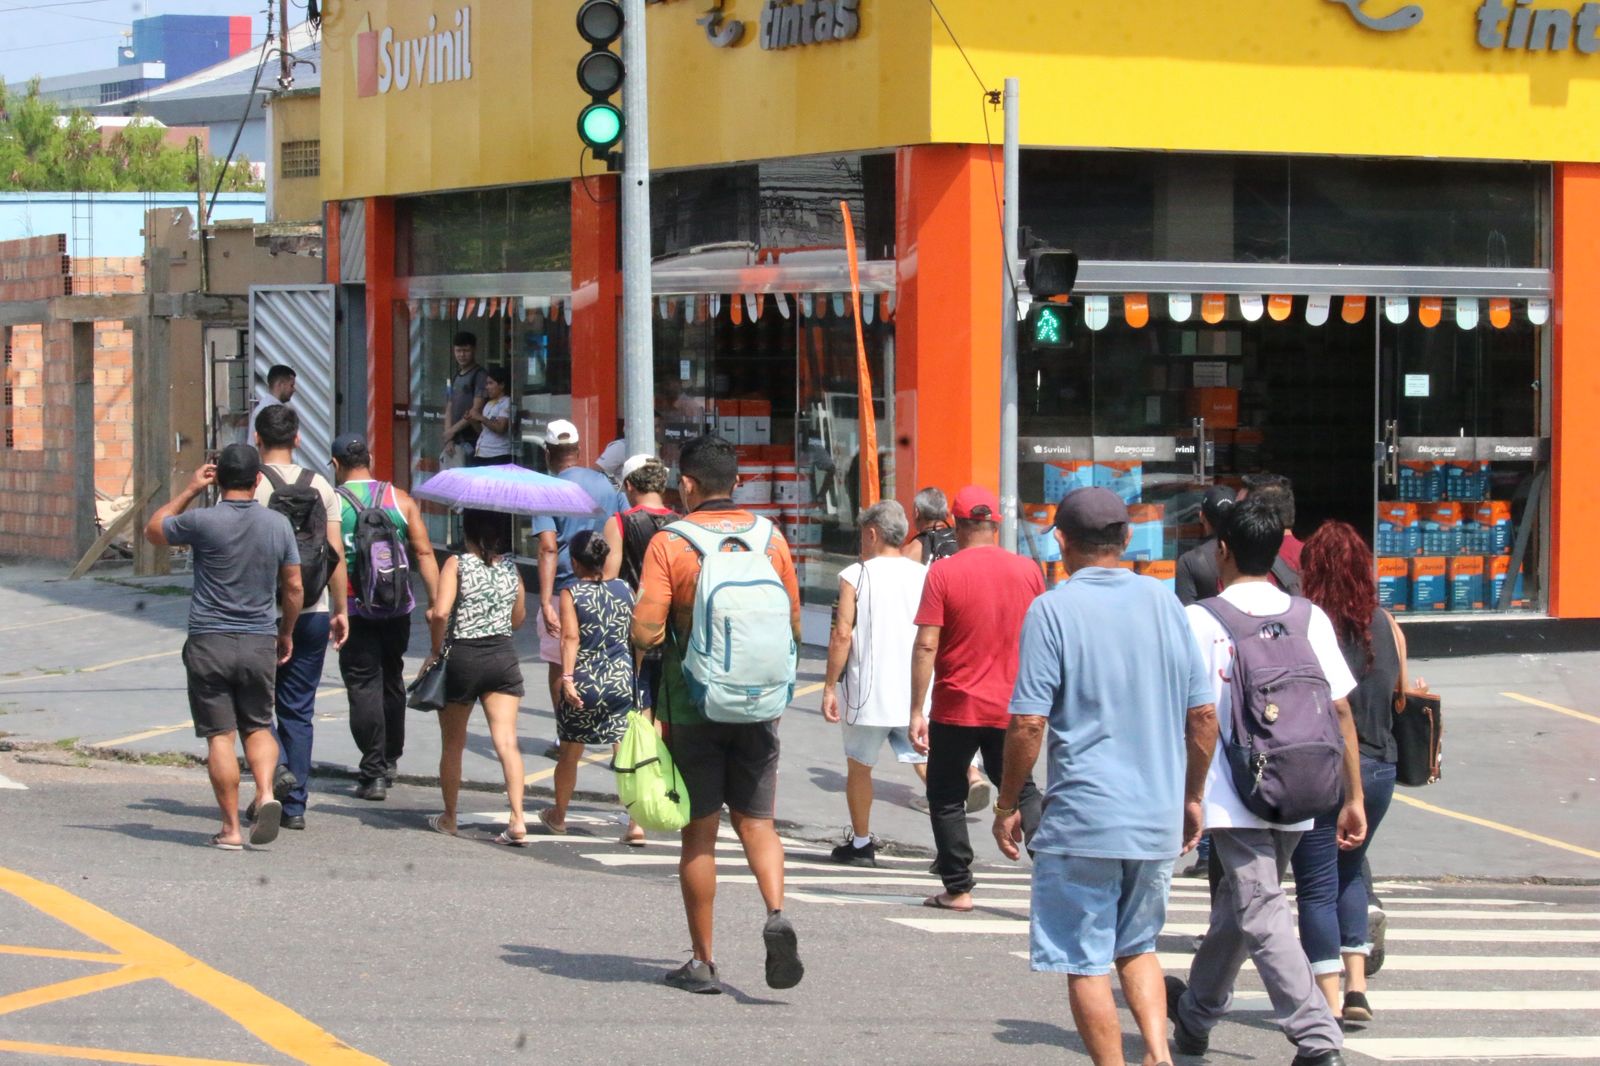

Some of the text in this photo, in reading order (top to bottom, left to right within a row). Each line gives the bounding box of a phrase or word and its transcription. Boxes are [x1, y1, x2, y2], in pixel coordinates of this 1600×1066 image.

[378, 6, 472, 94] Suvinil
[760, 0, 860, 50] tintas
[1043, 445, 1071, 454] Suvinil
